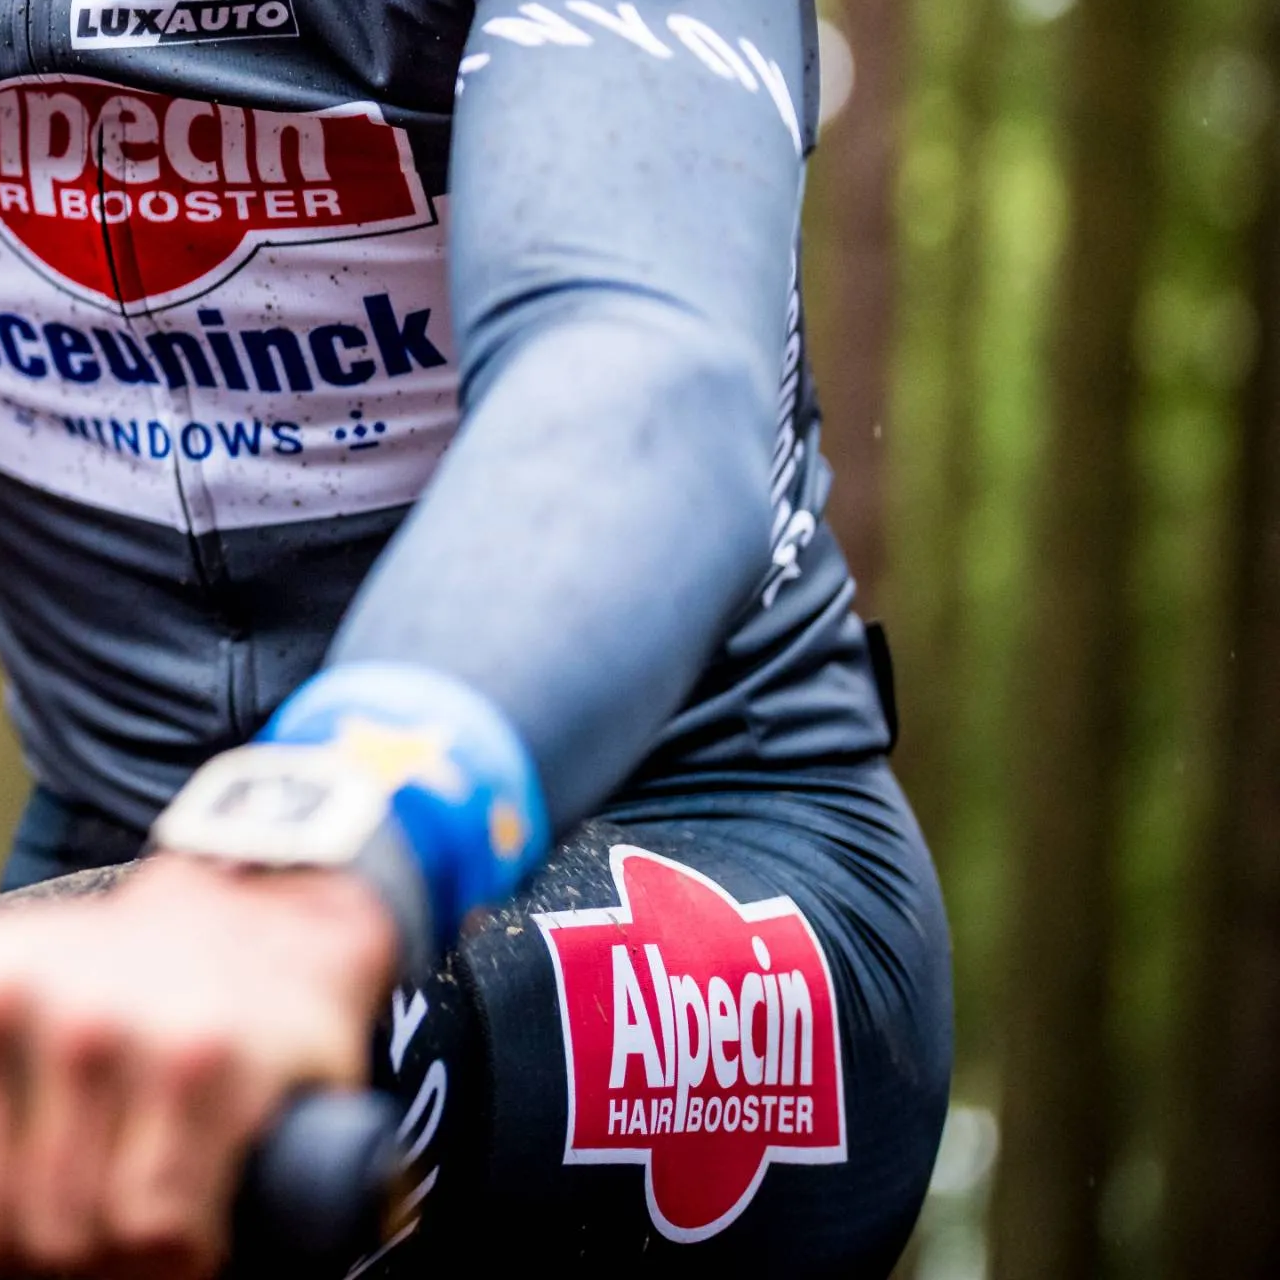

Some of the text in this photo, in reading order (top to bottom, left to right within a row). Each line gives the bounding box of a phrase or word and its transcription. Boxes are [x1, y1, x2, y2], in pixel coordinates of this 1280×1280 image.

[76, 0, 290, 39] LUXAUTO
[59, 188, 342, 224] BOOSTER
[608, 935, 815, 1134] Alpecin
[607, 1094, 814, 1135] HAIR BOOSTER
